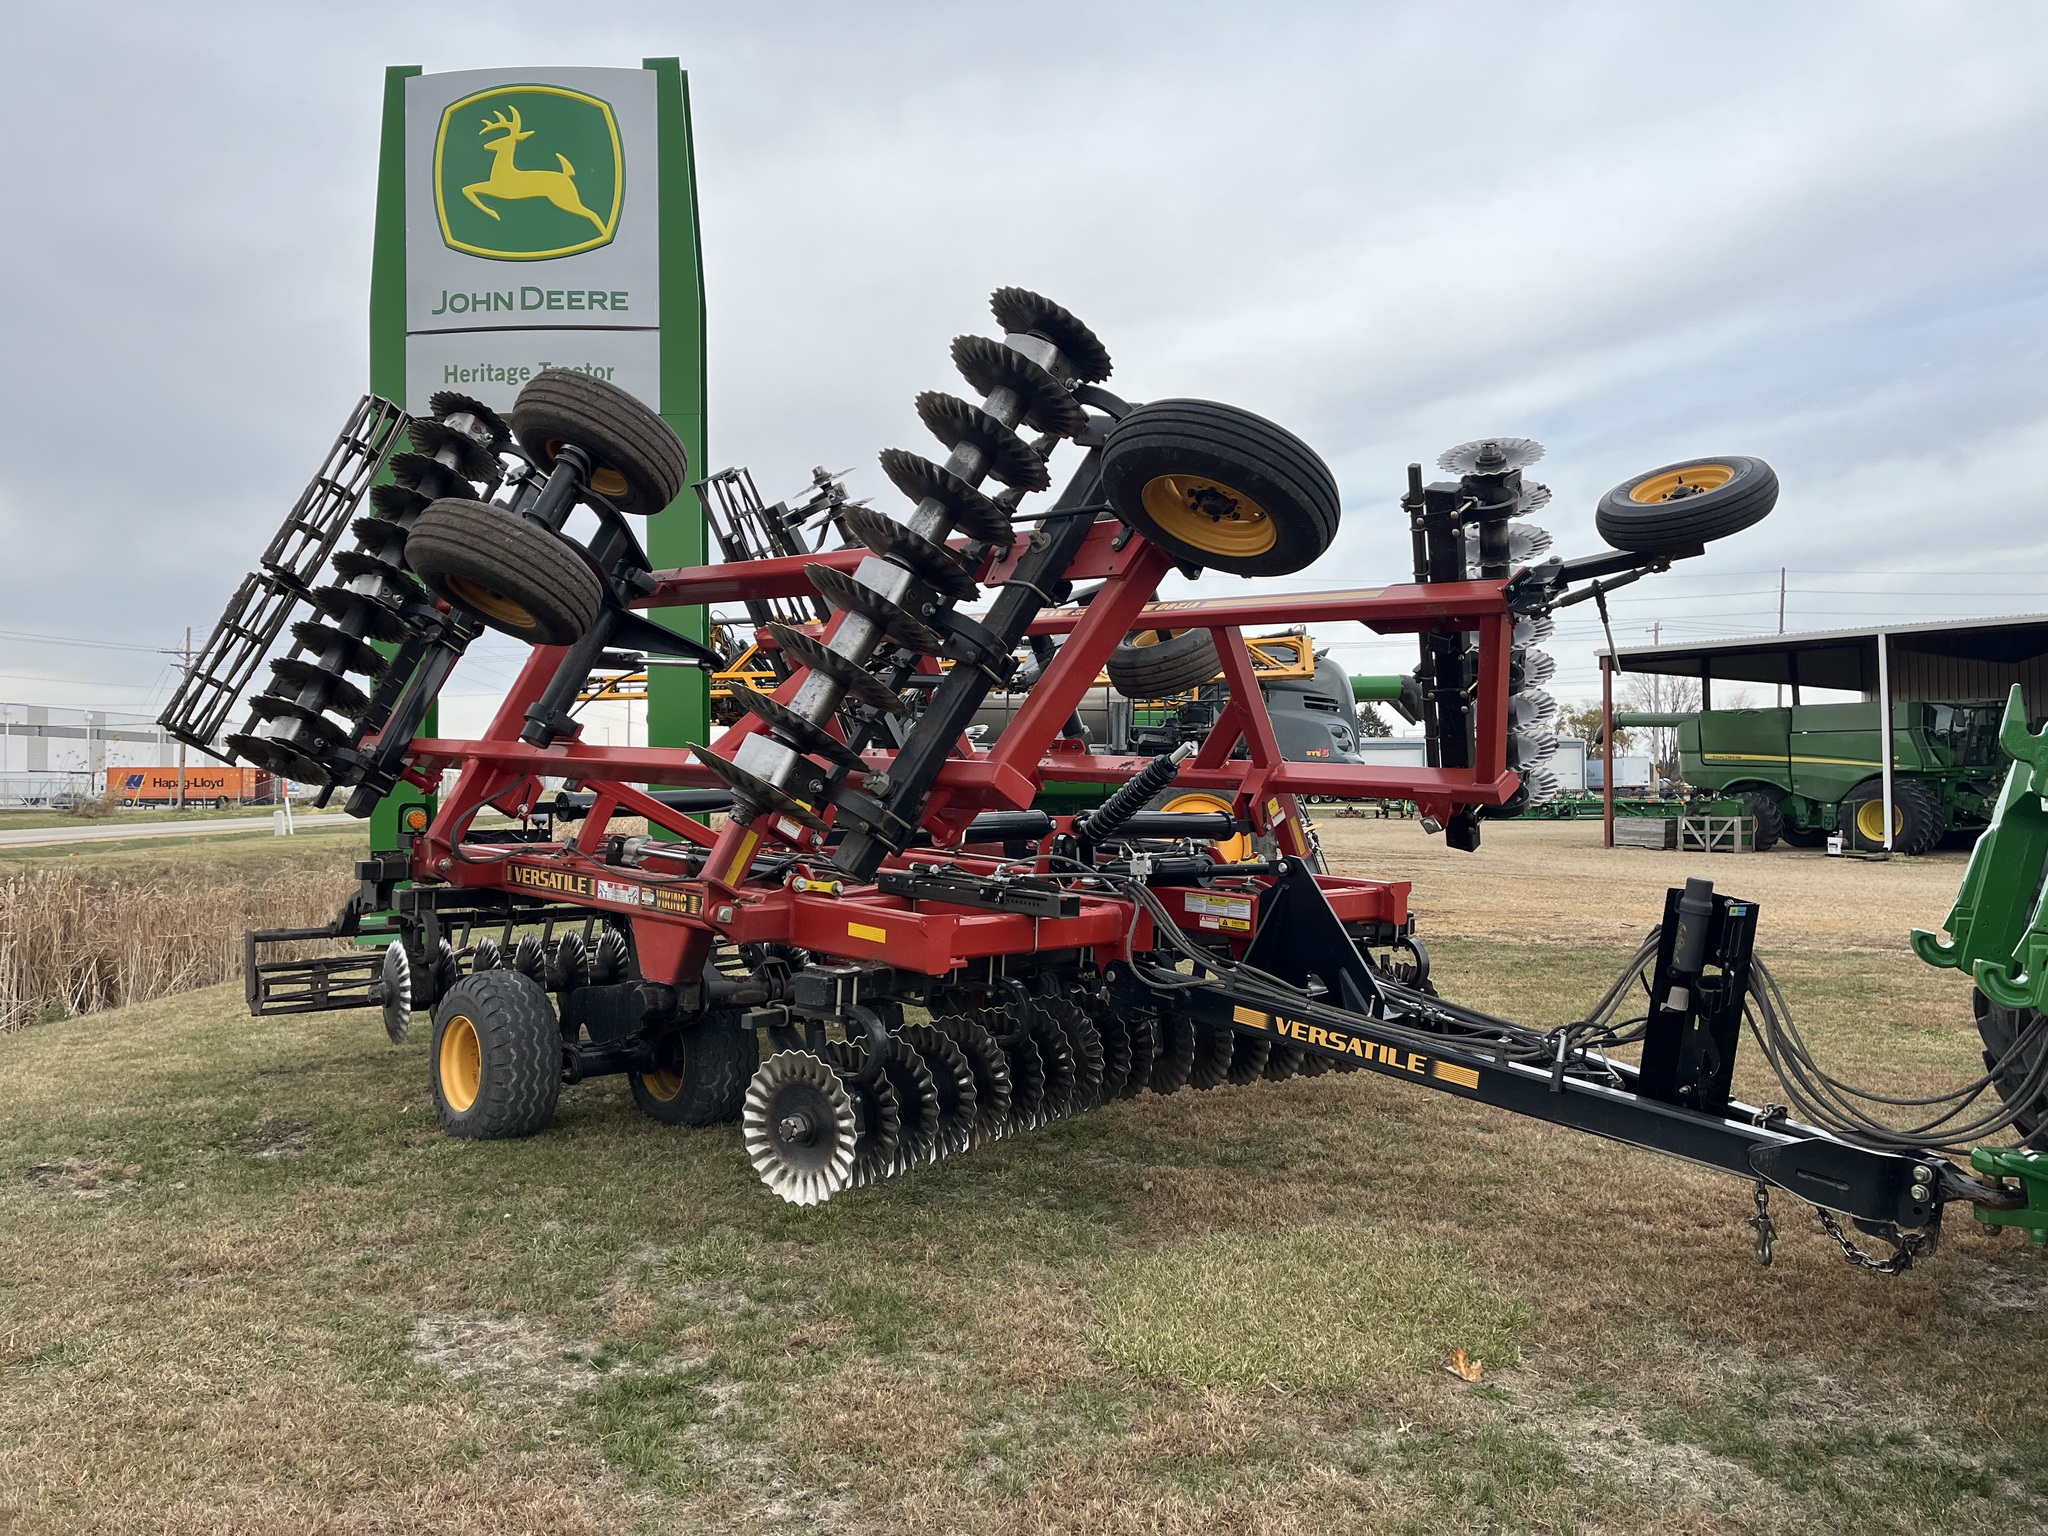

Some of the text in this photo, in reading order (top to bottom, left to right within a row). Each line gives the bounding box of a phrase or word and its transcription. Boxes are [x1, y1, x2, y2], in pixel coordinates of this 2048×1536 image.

[431, 286, 629, 315] JOHN DEERE
[443, 363, 531, 386] Heritage
[514, 866, 587, 895] VERSATILE
[655, 889, 687, 913] VIKING
[1275, 1016, 1427, 1074] VERSATILE
